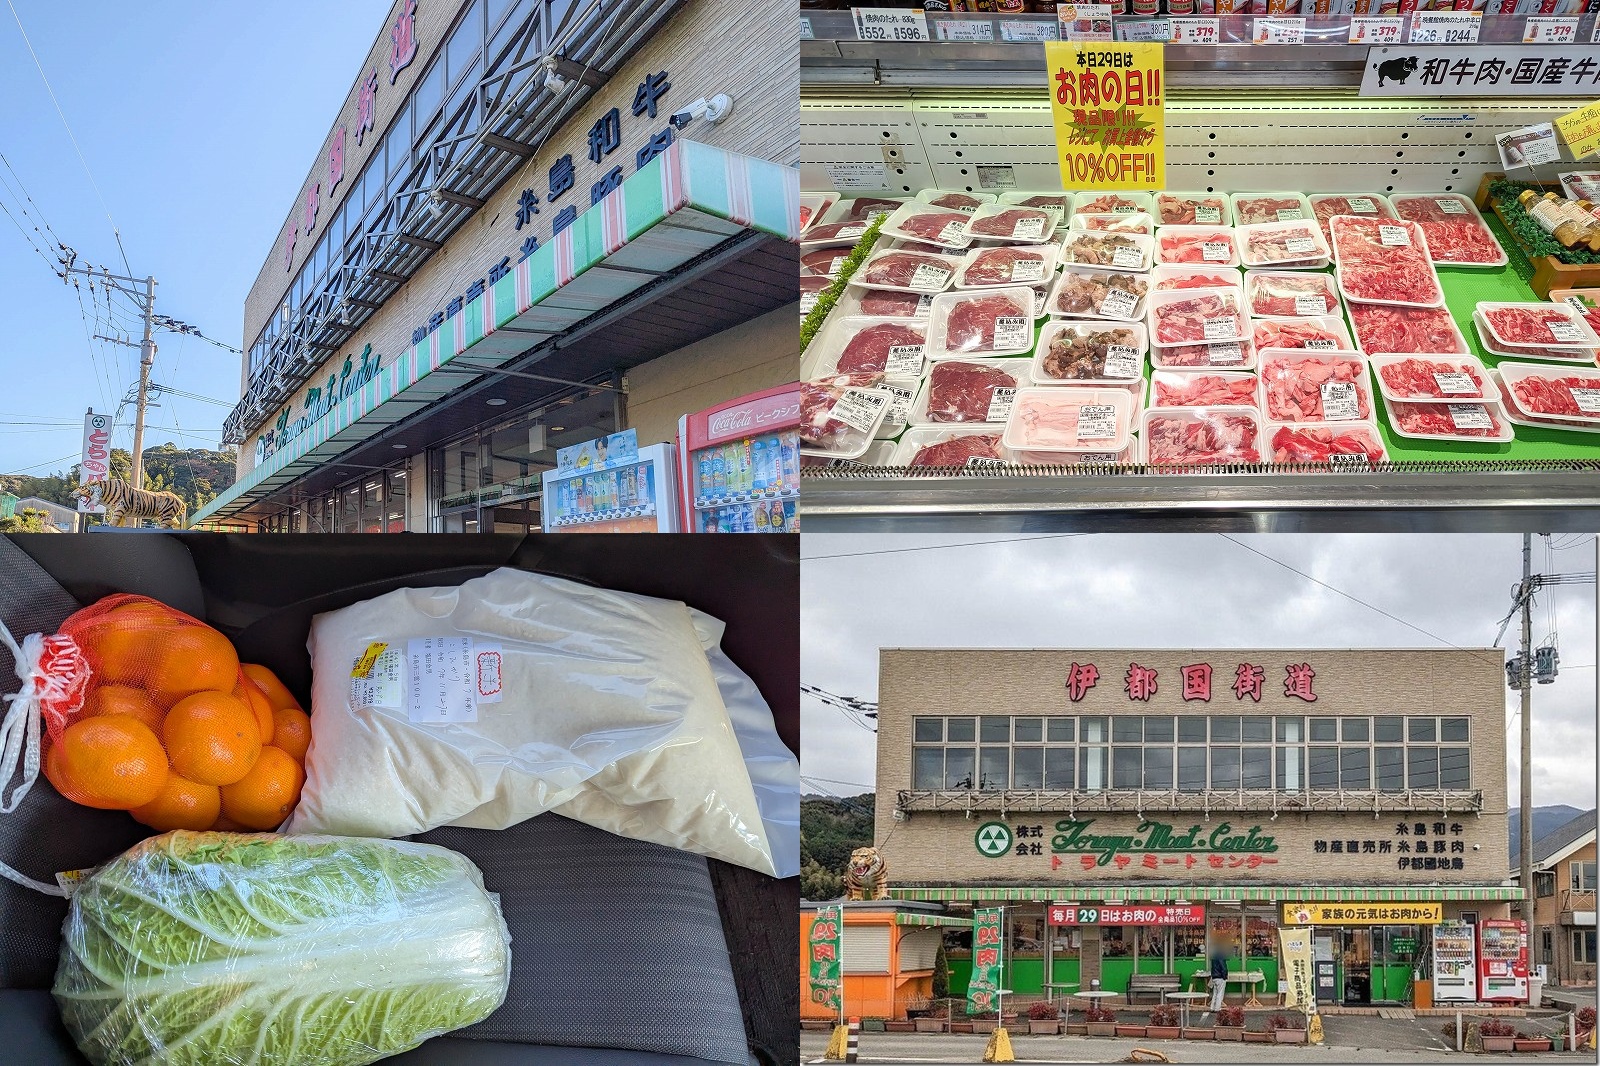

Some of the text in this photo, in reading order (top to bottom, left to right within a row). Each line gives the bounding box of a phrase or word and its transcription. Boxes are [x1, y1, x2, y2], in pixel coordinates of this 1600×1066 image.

[1378, 26, 1397, 36] 379
[1552, 26, 1572, 36] 379
[1076, 51, 1134, 68] 本日29日は
[1420, 57, 1600, 86] 和牛肉・国産牛
[1055, 67, 1161, 107] お肉の日!!
[514, 70, 672, 231] 糸島和牛
[1065, 152, 1156, 184] 10%OFF!!
[1066, 662, 1318, 702] 伊都国街道
[1016, 825, 1043, 839] 株式
[1395, 822, 1463, 836] 糸島和牛
[1016, 842, 1043, 856] 会社
